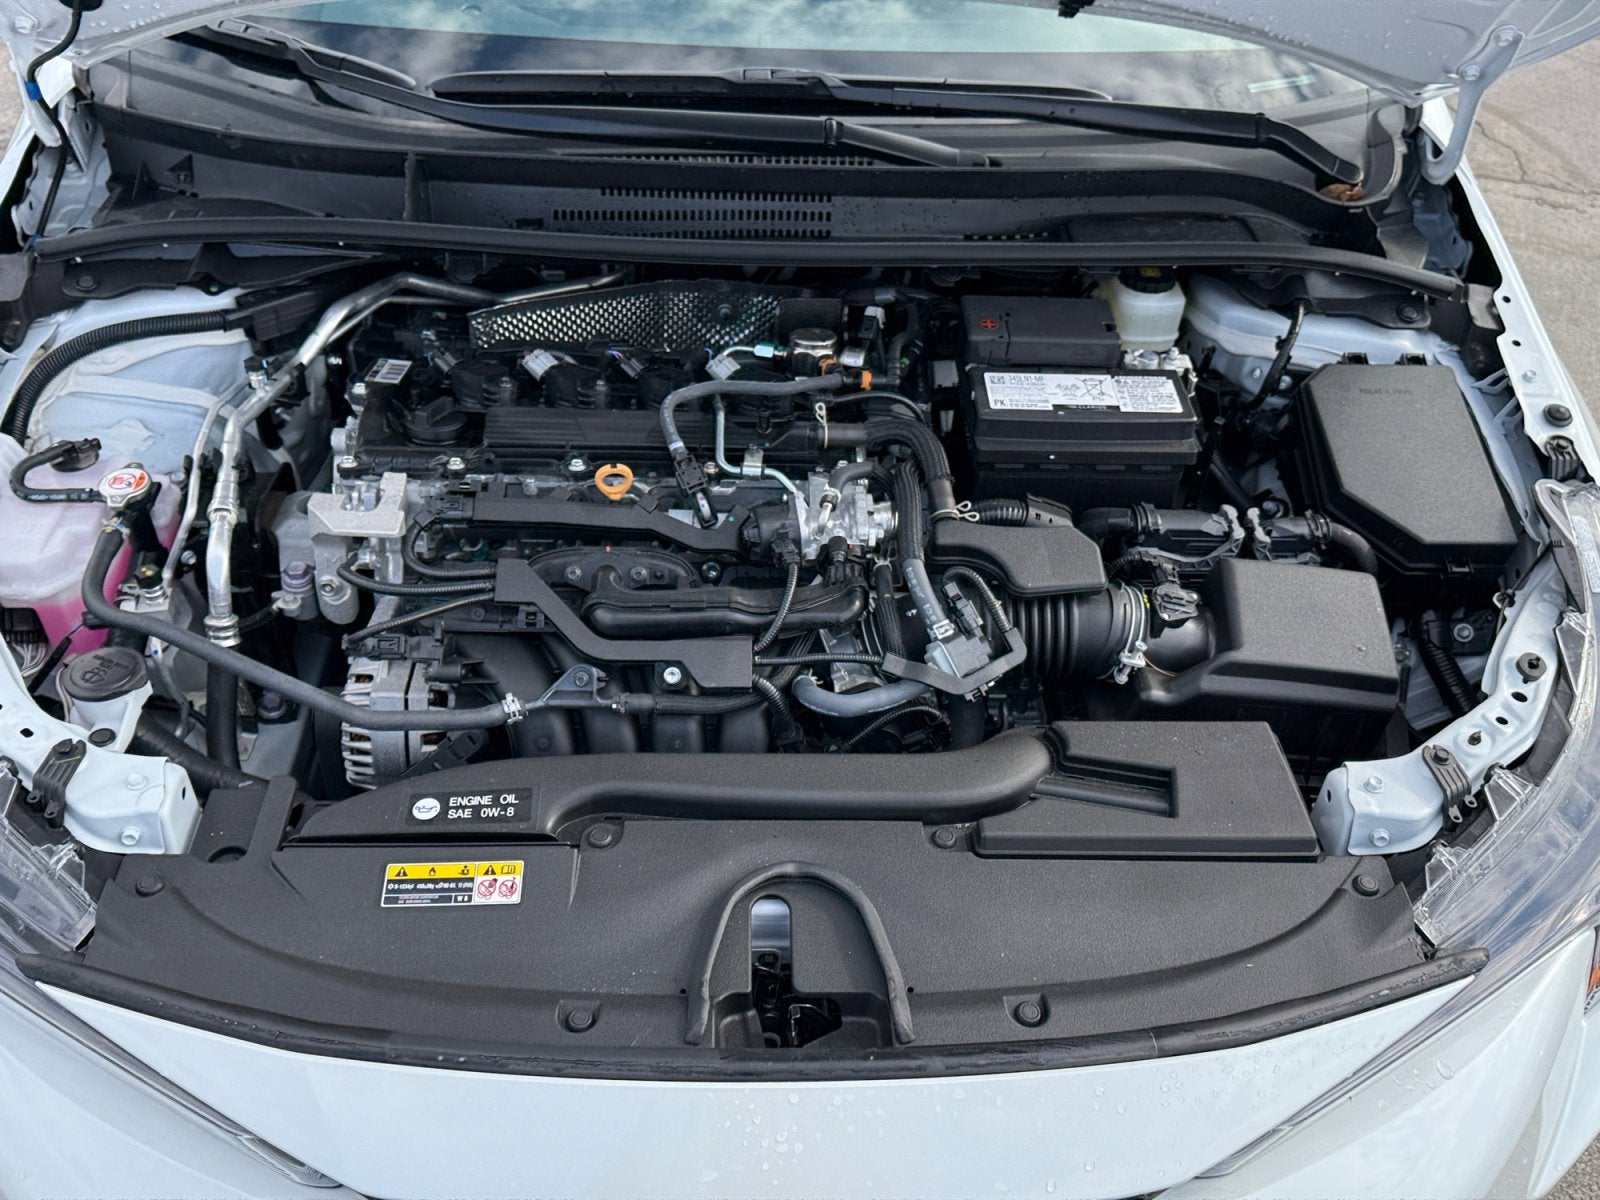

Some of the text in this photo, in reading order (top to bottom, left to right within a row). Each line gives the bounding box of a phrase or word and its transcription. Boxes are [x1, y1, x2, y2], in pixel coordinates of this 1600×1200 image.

[449, 793, 519, 806] ENGINE OIL
[447, 807, 515, 818] SAE 0W-8
